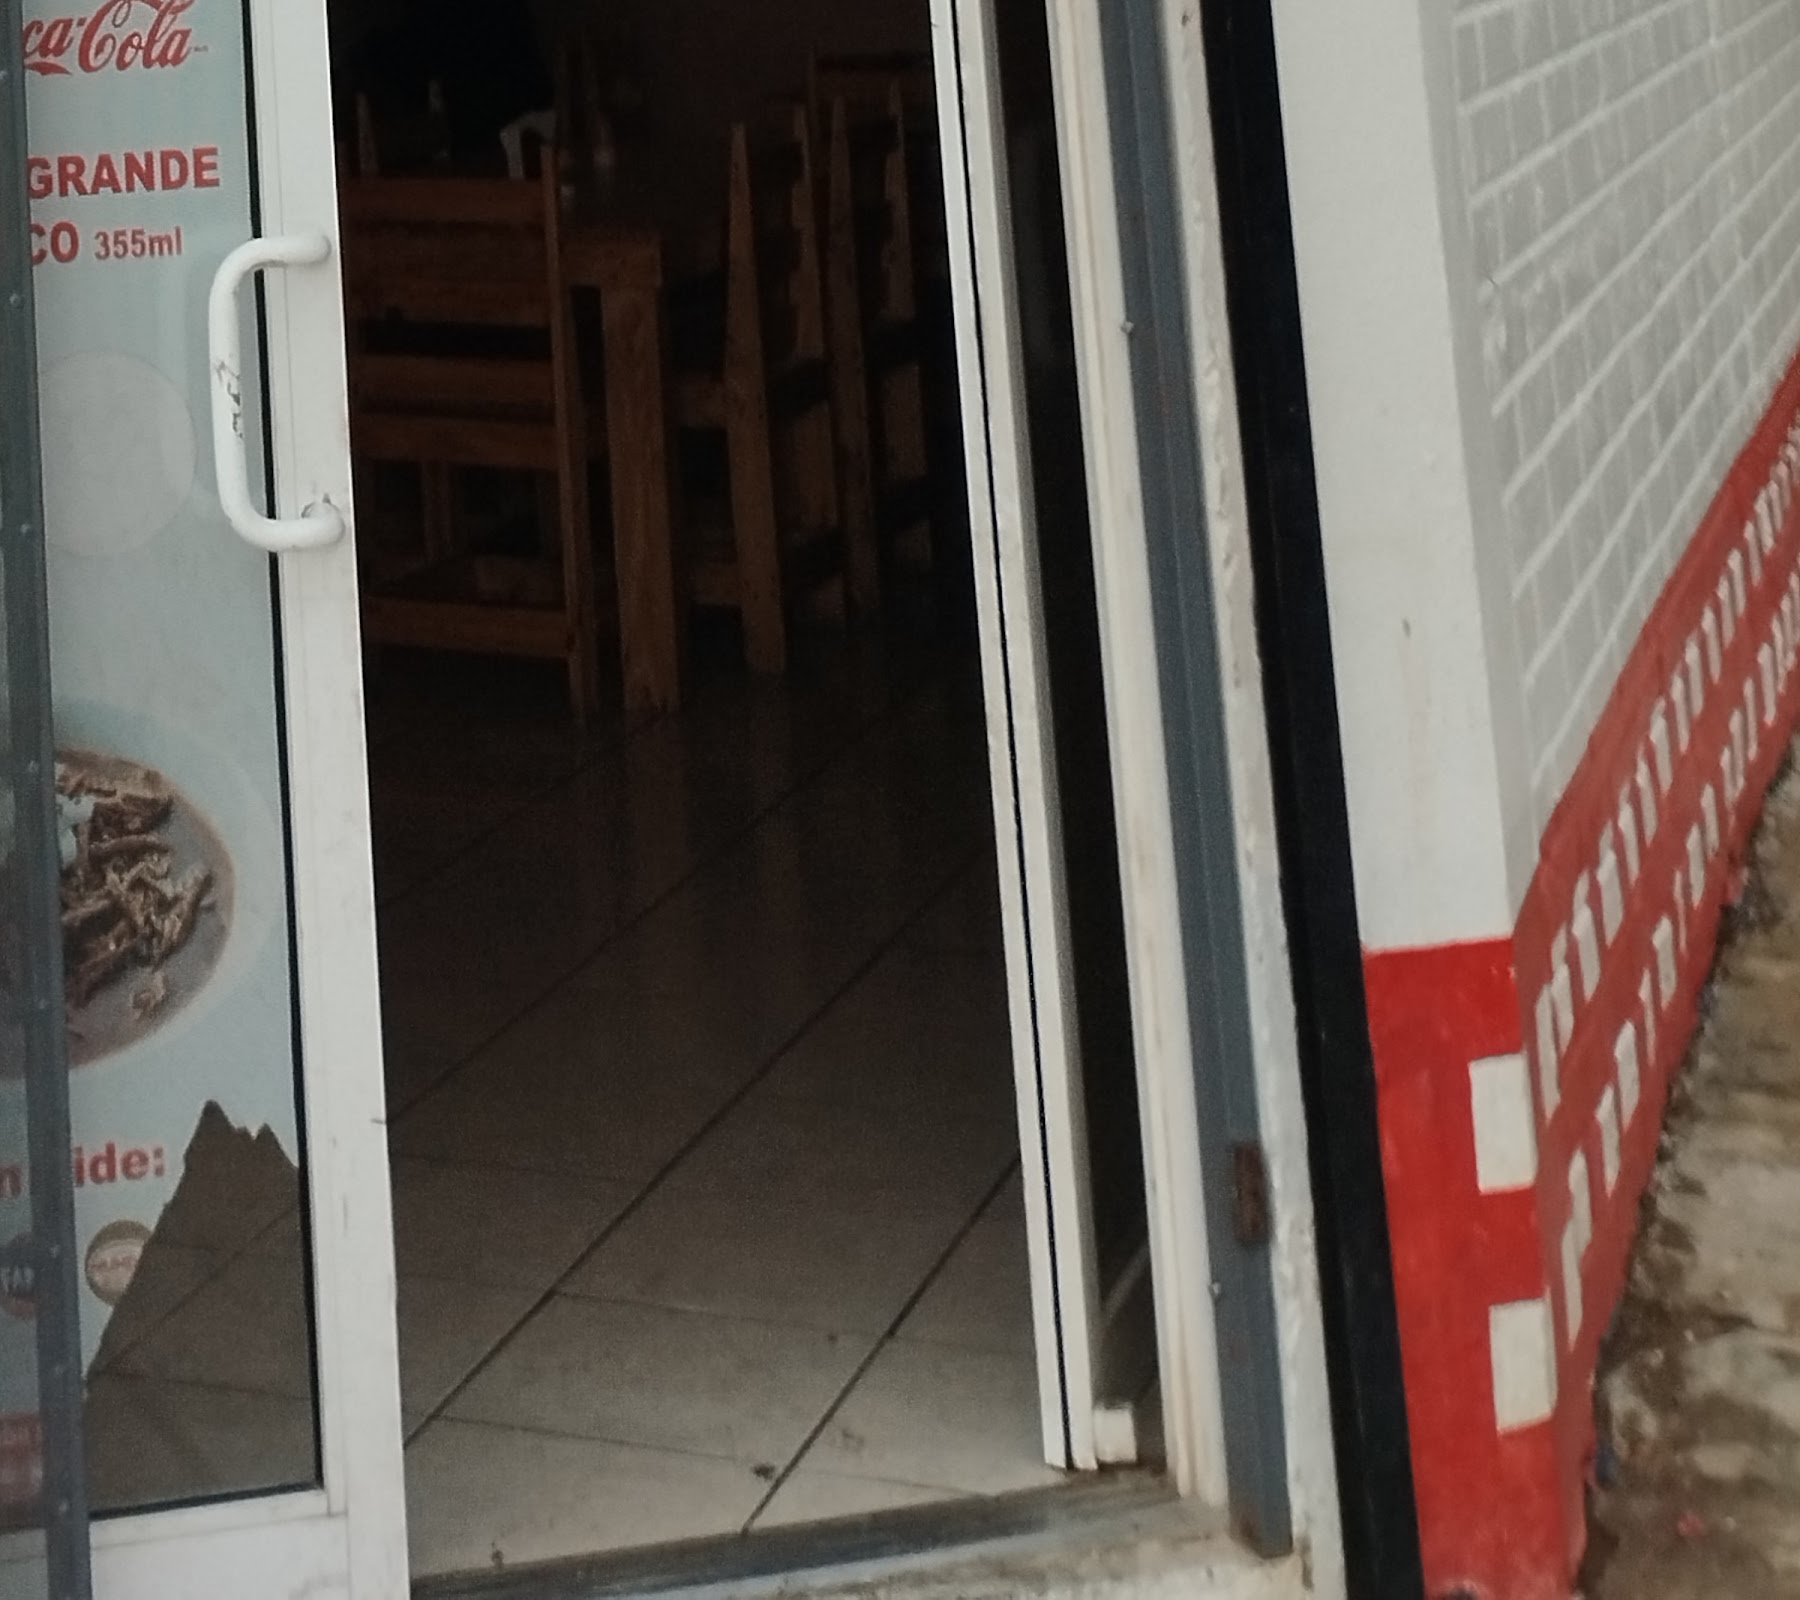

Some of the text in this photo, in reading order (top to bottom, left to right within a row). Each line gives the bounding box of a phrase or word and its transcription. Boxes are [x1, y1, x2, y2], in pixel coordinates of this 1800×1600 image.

[27, 146, 220, 200] GRANDE
[93, 226, 183, 261] 355ml
[71, 1141, 164, 1187] ide:
